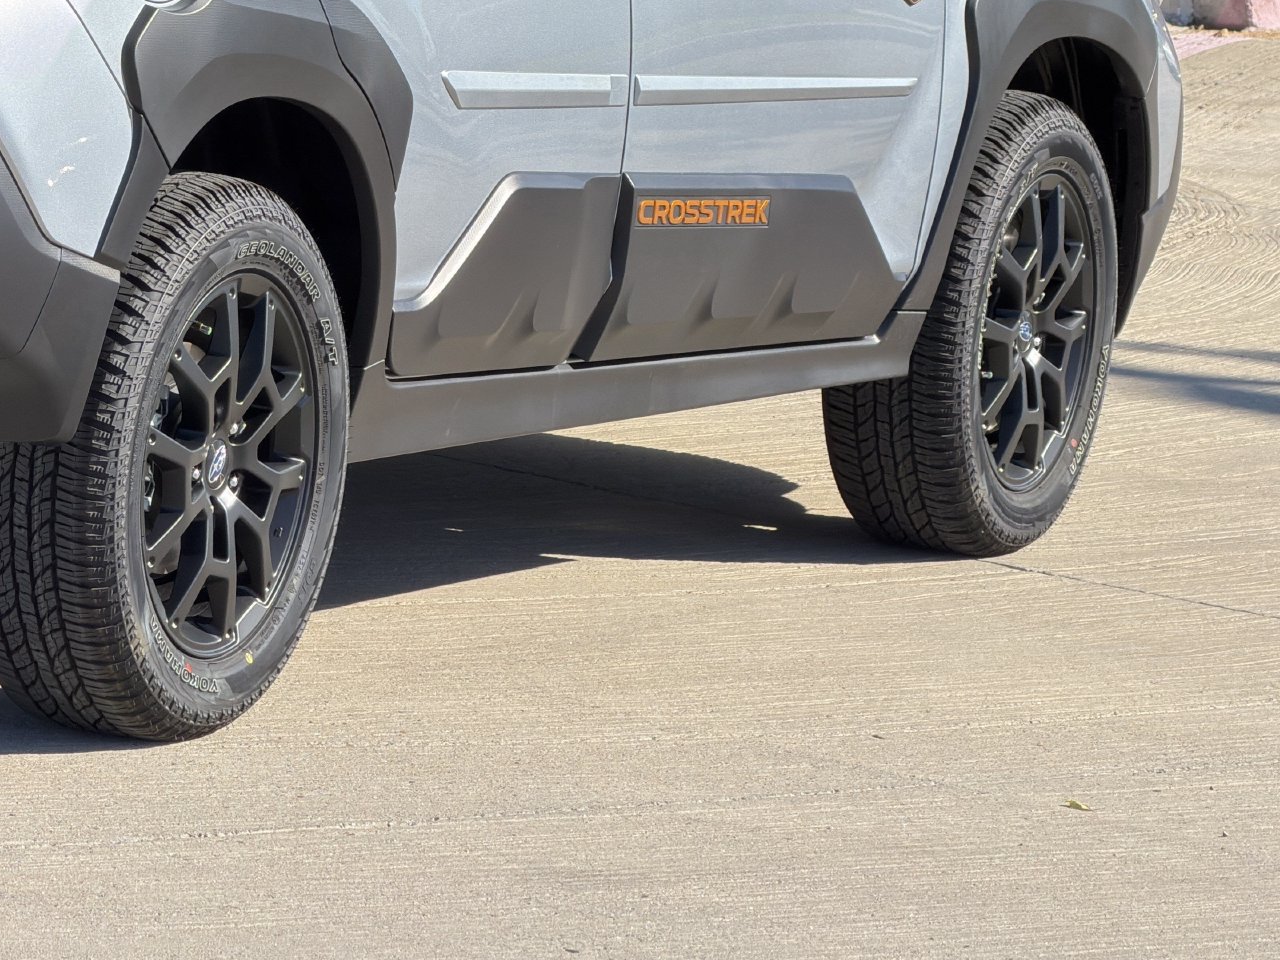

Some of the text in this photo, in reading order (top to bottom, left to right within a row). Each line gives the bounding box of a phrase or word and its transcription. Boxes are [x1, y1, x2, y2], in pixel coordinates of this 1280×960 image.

[638, 199, 770, 225] CROSSTREK
[1068, 344, 1110, 476] YOKOHAMA
[150, 614, 221, 694] YOKOHAMA
